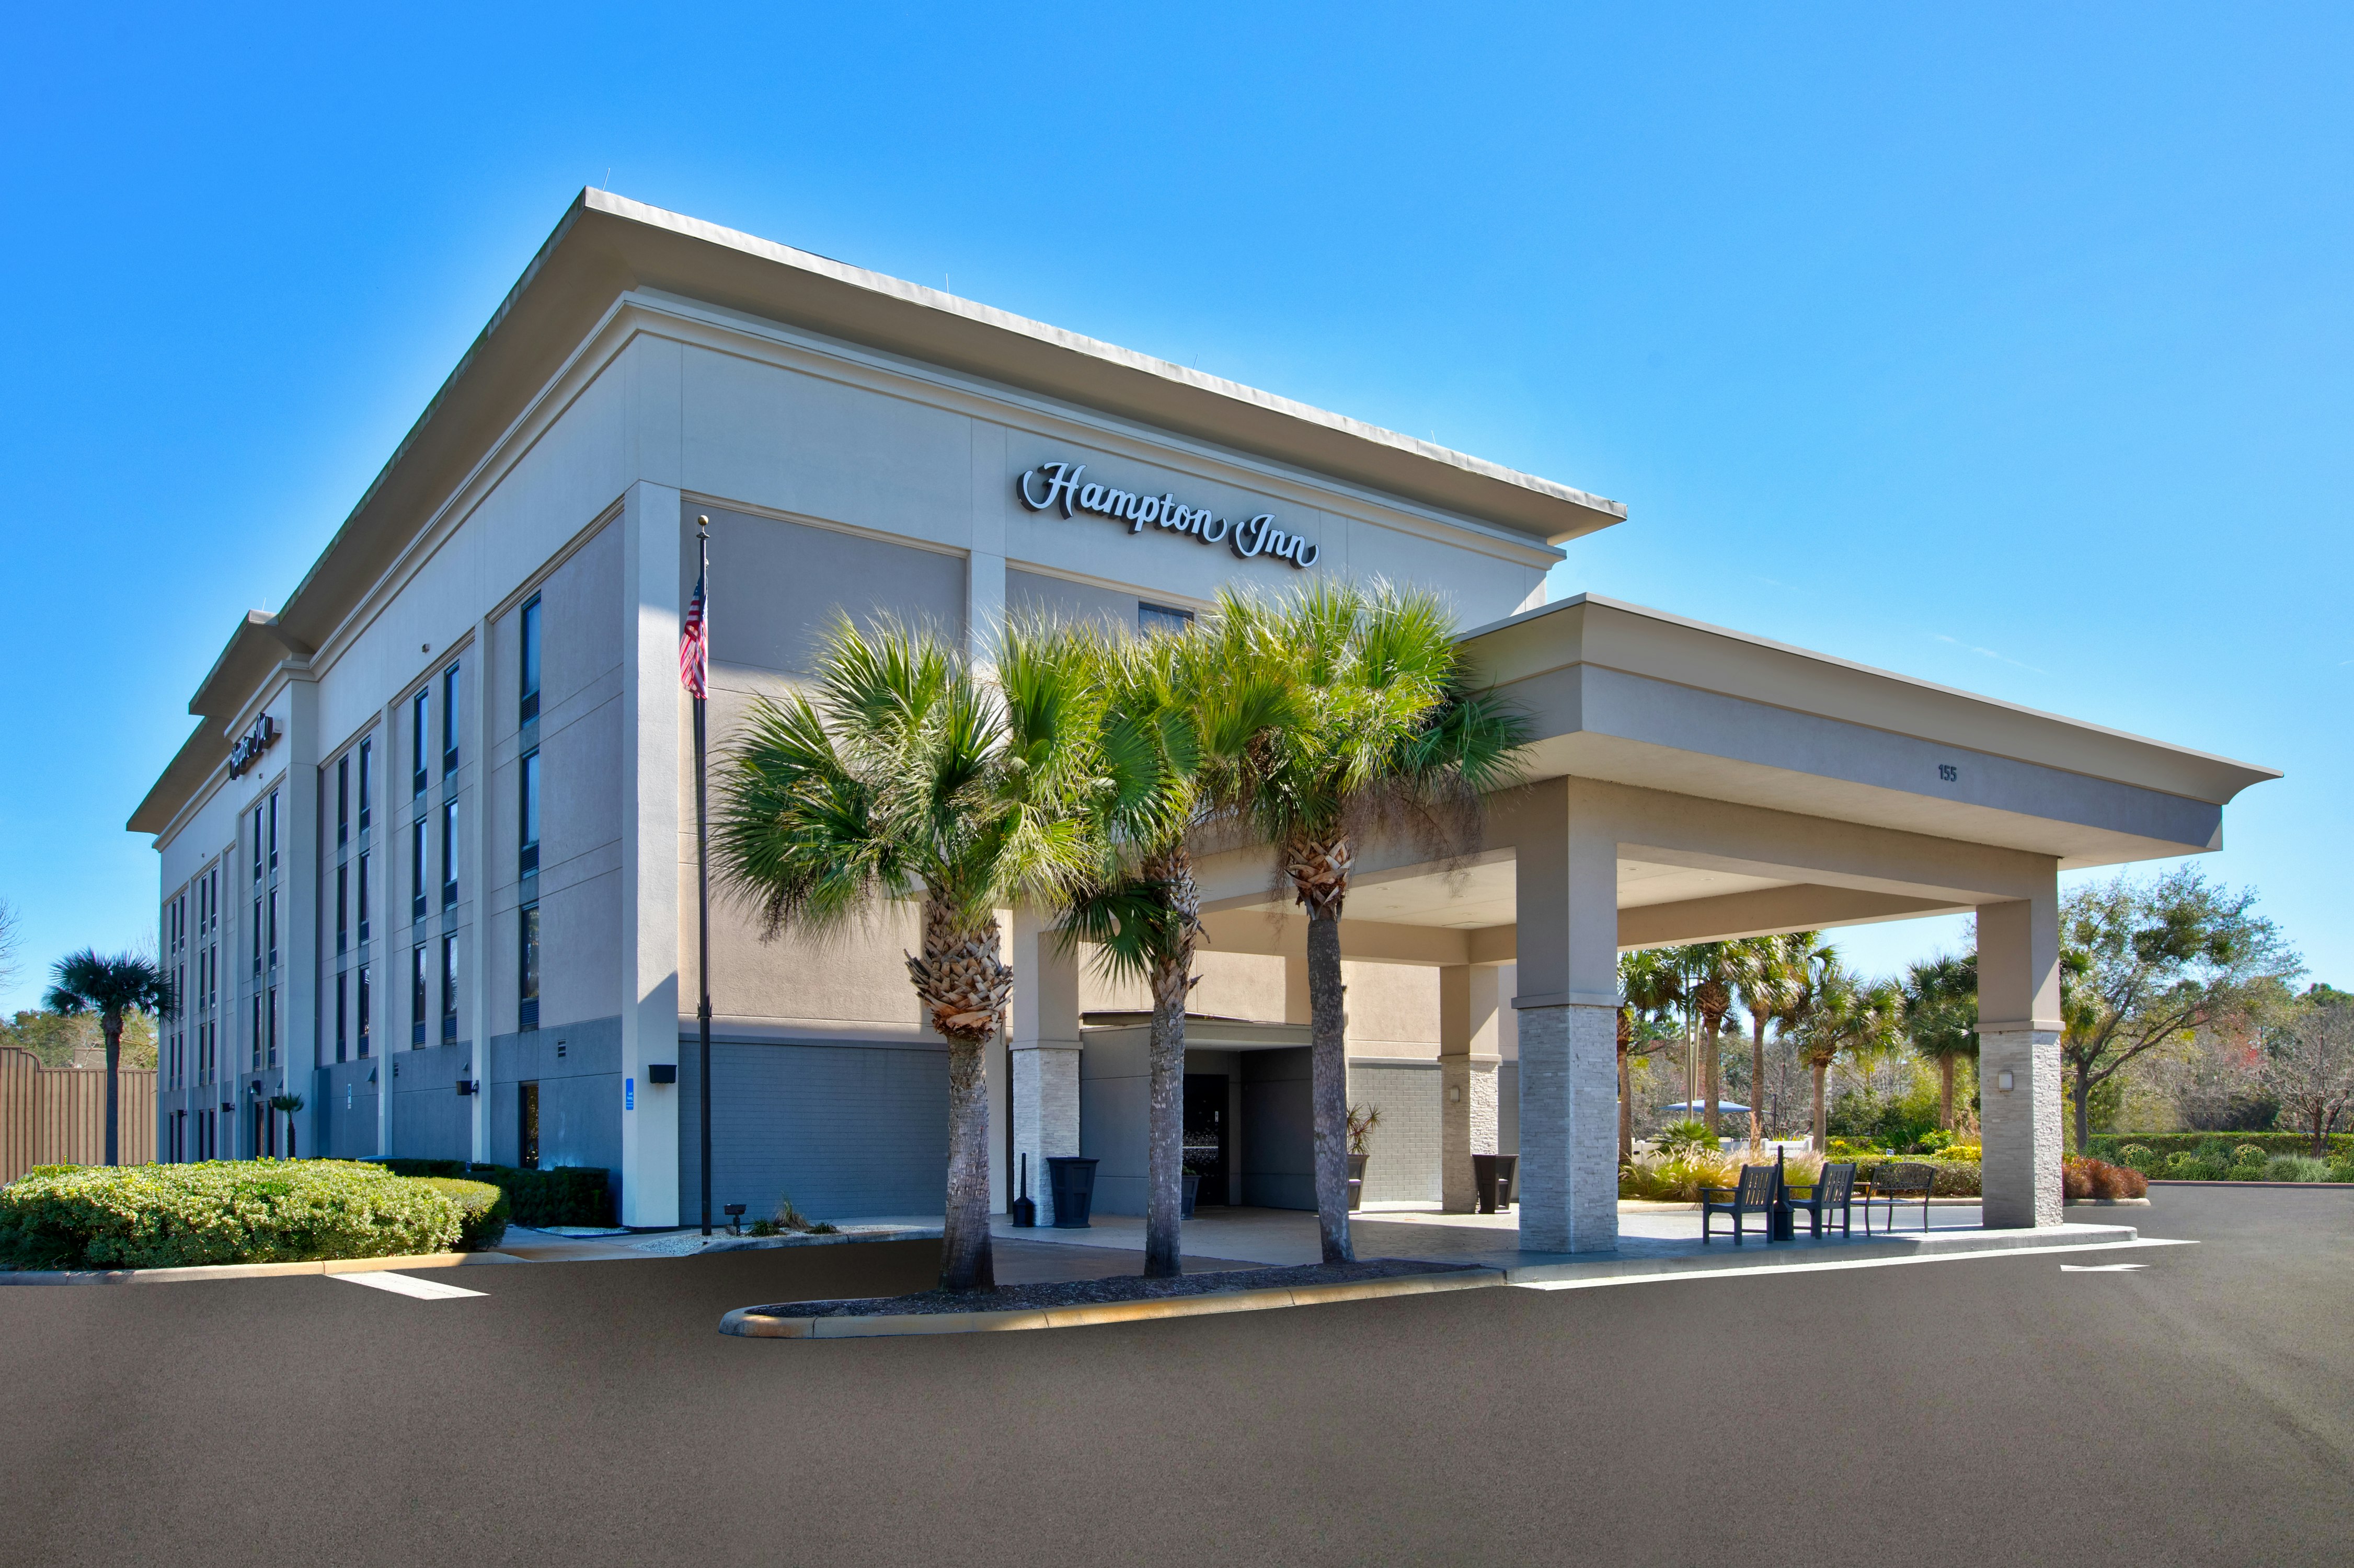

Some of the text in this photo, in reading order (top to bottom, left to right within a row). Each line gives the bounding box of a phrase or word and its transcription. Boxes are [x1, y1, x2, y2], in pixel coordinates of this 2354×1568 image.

[1022, 462, 1319, 568] Hampton Inn
[1938, 764, 1957, 782] 155
